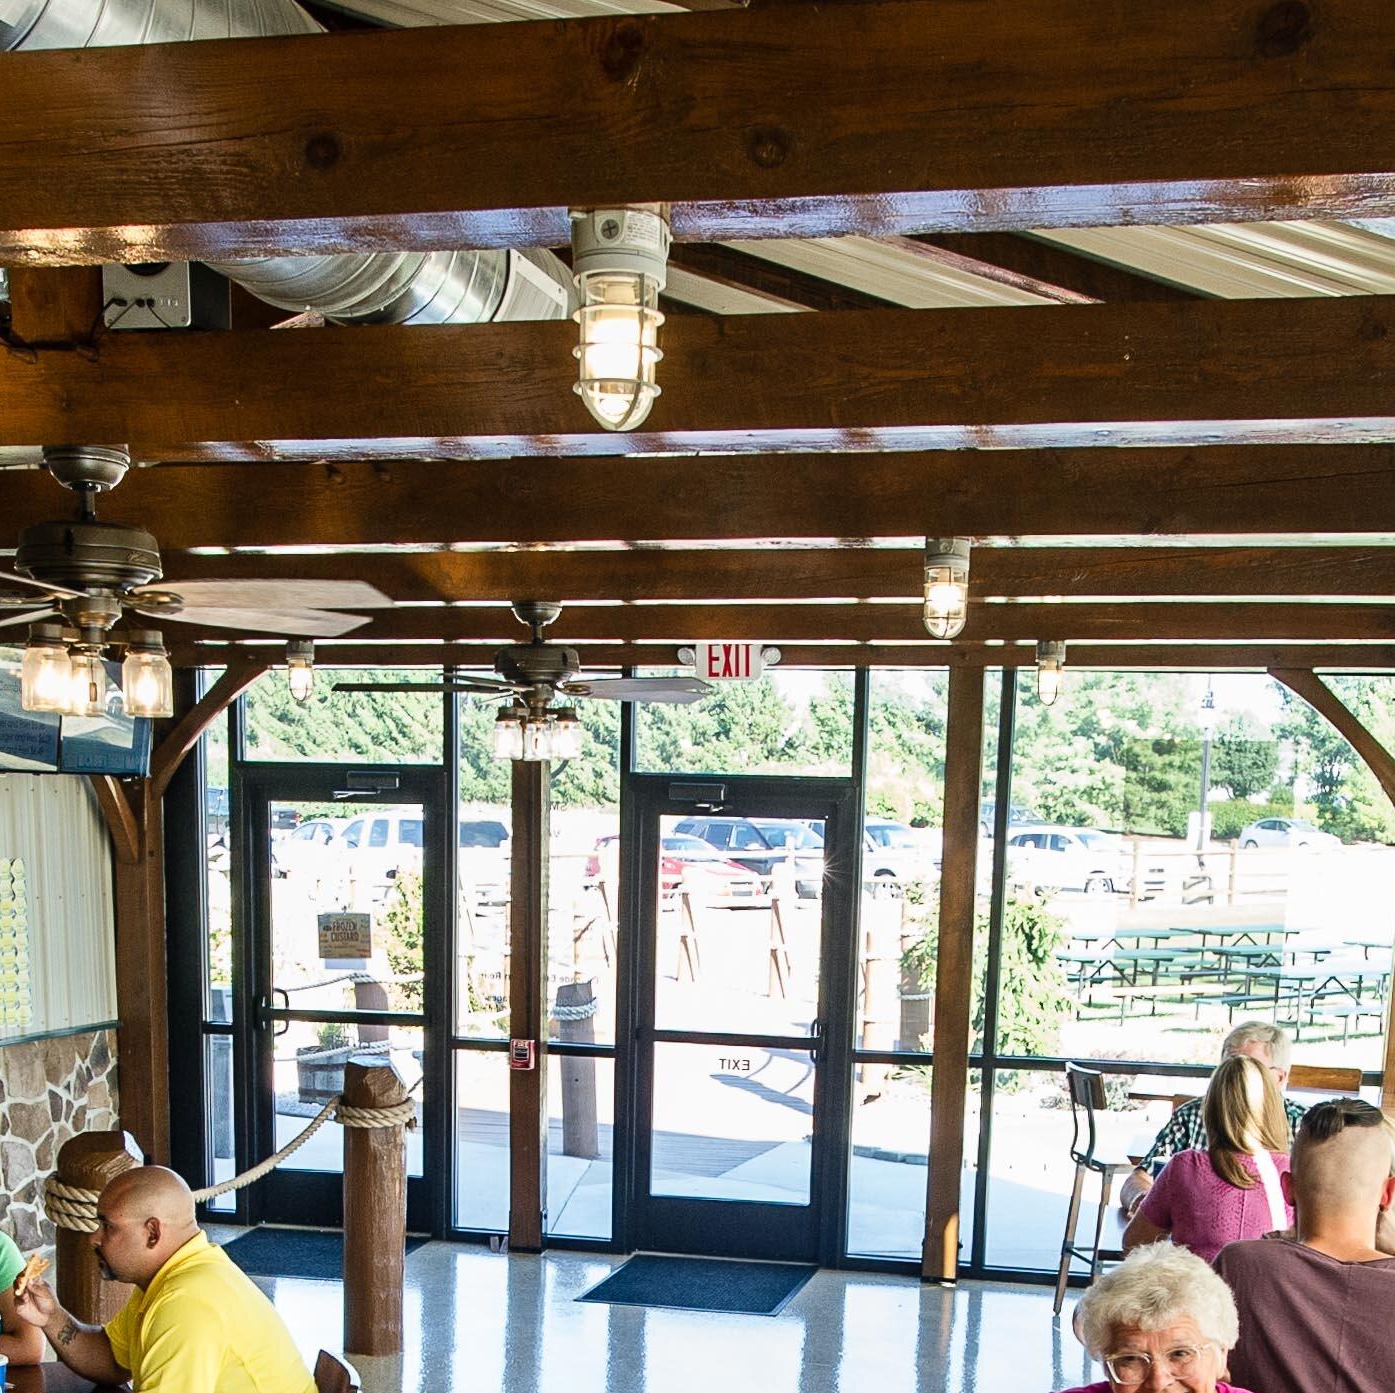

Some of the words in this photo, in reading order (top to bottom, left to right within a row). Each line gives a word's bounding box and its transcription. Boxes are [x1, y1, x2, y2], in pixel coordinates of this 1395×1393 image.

[708, 644, 754, 677] EXIT
[332, 920, 358, 932] FROZEN
[331, 931, 359, 942] CUSTARD
